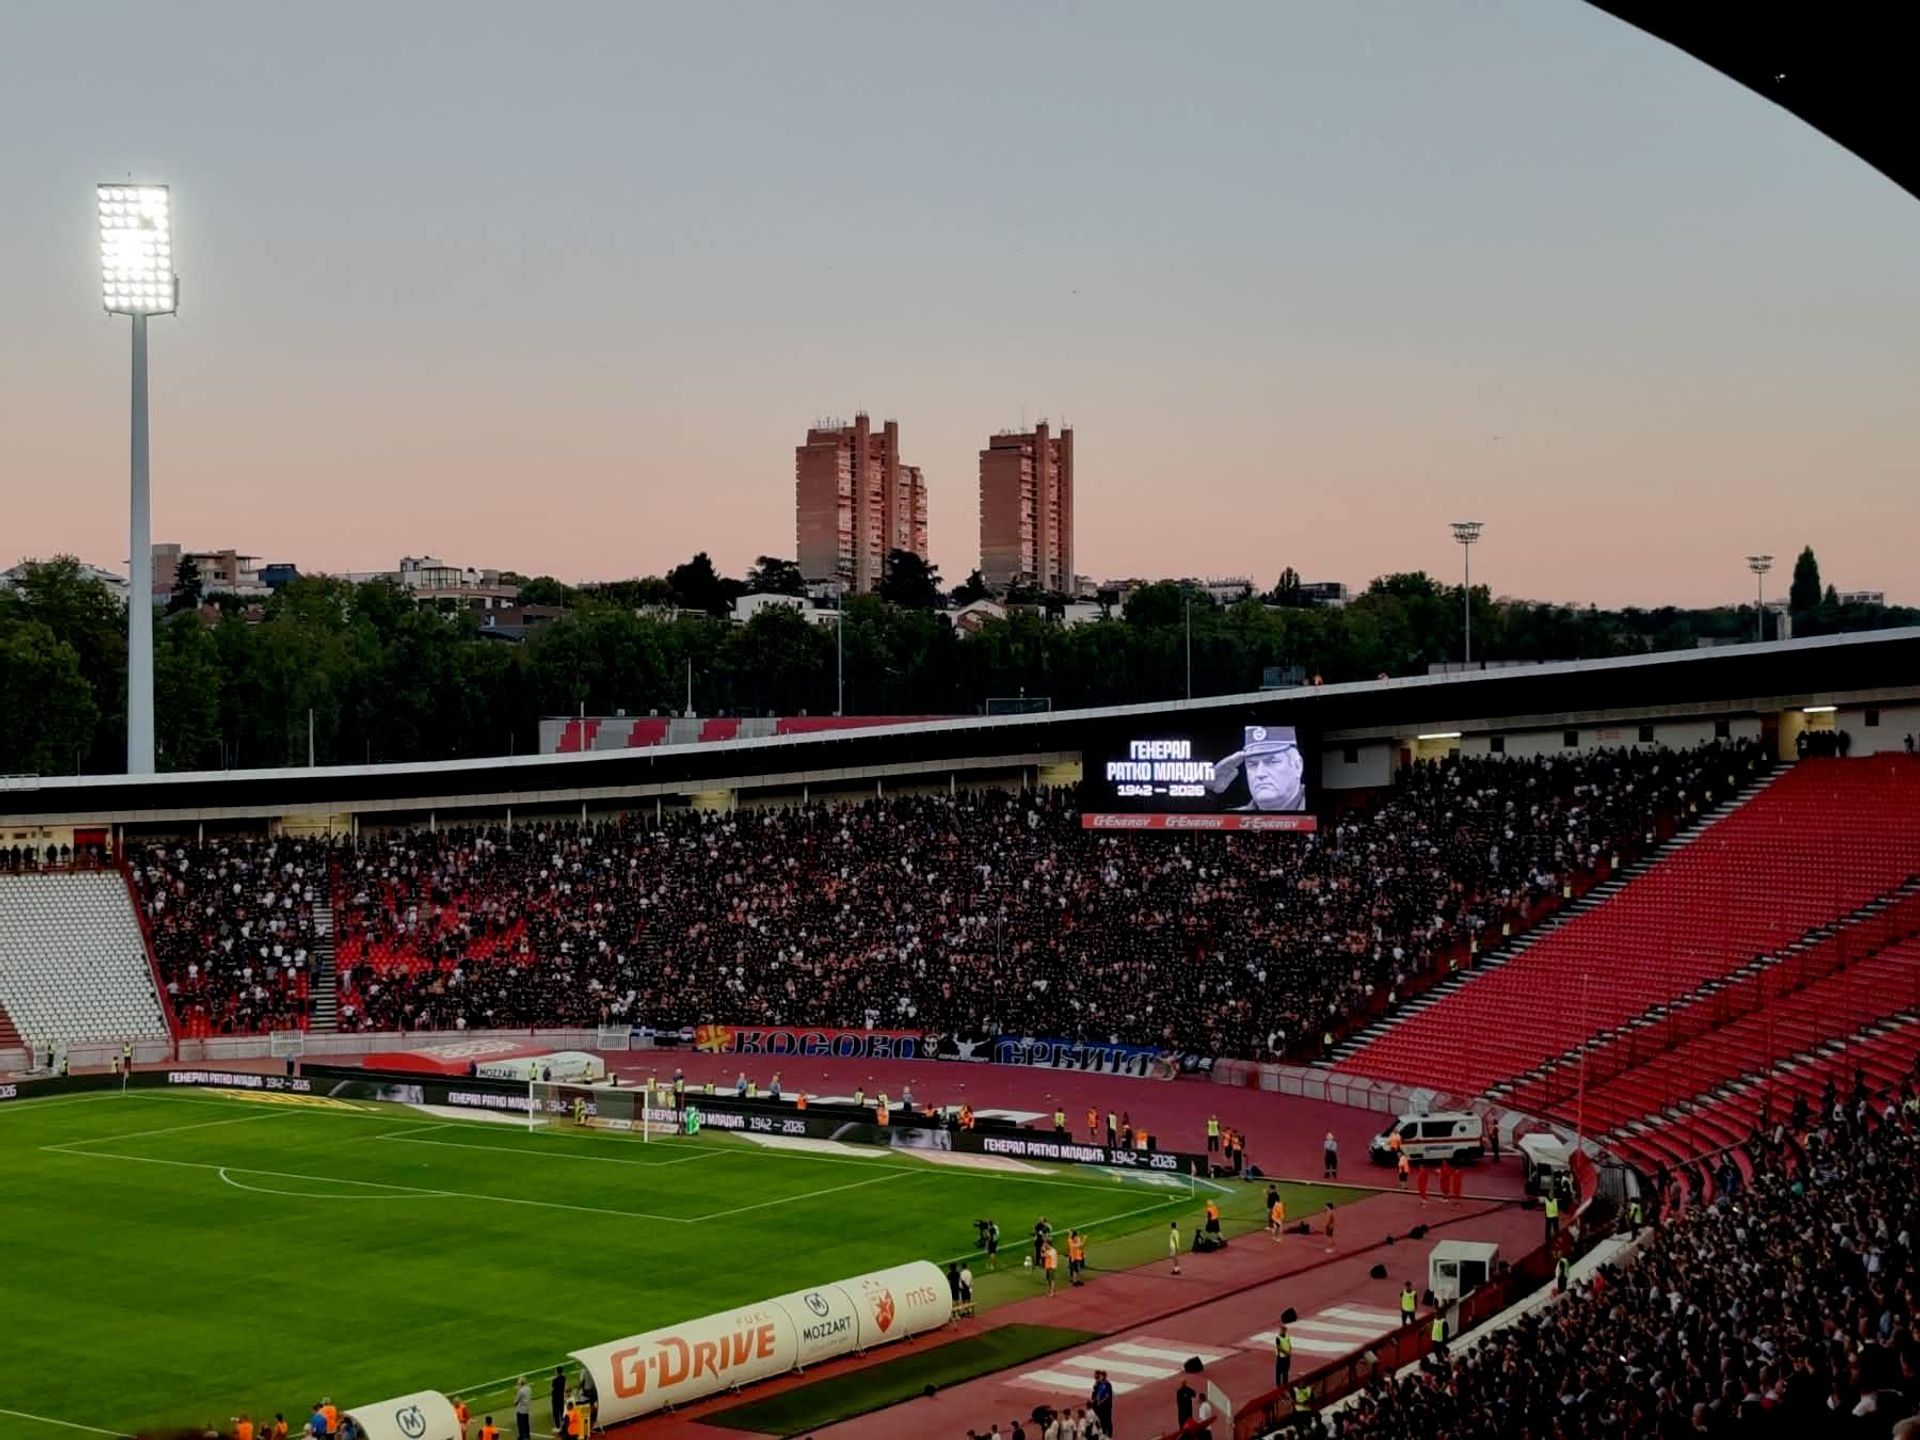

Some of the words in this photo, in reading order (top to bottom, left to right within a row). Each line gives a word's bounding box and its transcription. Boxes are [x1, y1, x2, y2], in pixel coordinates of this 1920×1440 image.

[1130, 740, 1191, 760] ГЕНЕРАЛ
[1107, 762, 1151, 781] РАТКО
[1154, 762, 1215, 782] МЛАДИЋ
[1117, 785, 1152, 796] 1942
[1169, 785, 1205, 796] 2026
[984, 1138, 1025, 1155] ГЕНЕРАЛ
[1027, 1143, 1059, 1158] РАТКО
[1060, 1147, 1104, 1162] МЛАДИЋ
[1111, 1150, 1137, 1165] 1942
[1150, 1154, 1177, 1169] 2026
[906, 1287, 937, 1308] mts
[803, 1316, 851, 1342] MOZZART
